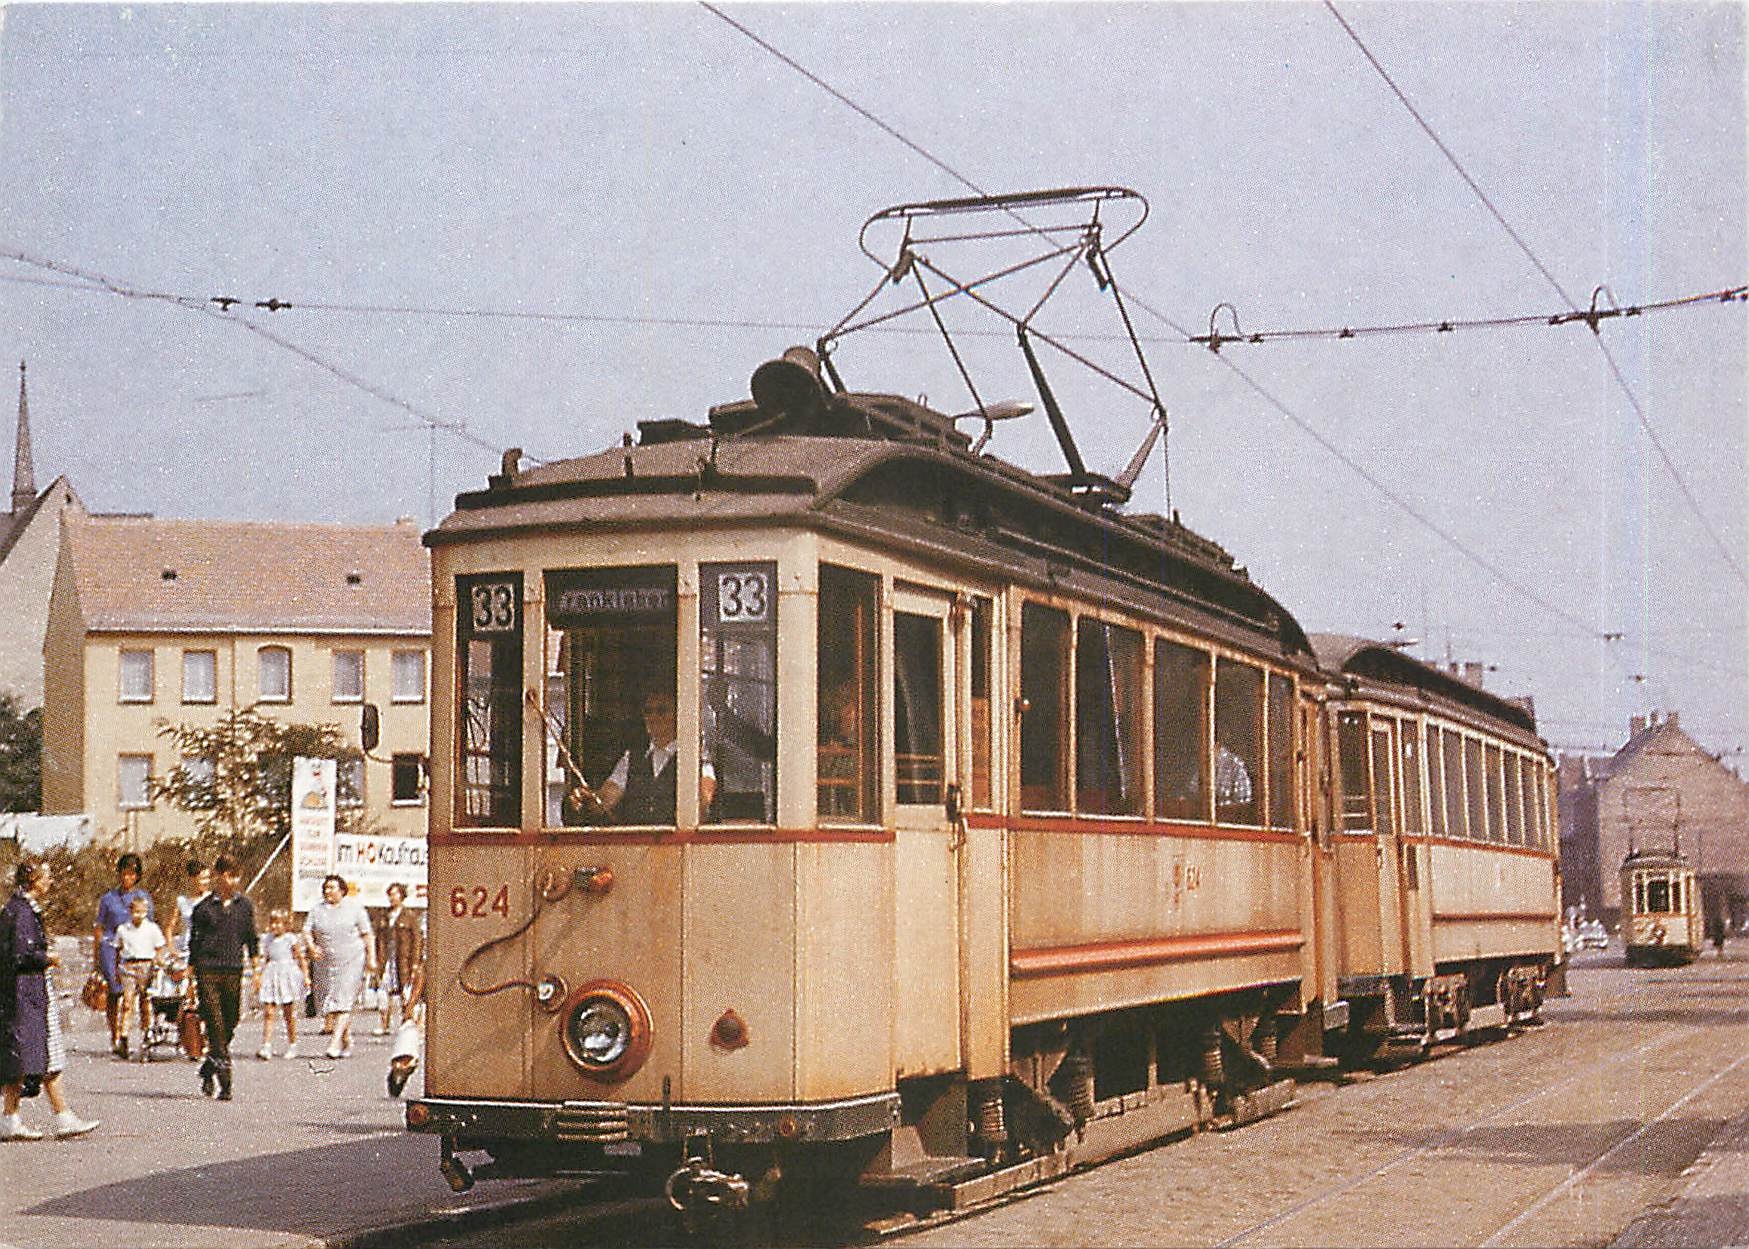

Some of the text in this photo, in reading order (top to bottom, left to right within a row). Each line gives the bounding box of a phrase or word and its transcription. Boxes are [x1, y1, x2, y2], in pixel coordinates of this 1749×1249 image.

[473, 583, 512, 625] 33
[722, 575, 764, 618] 33
[451, 885, 510, 919] 624
